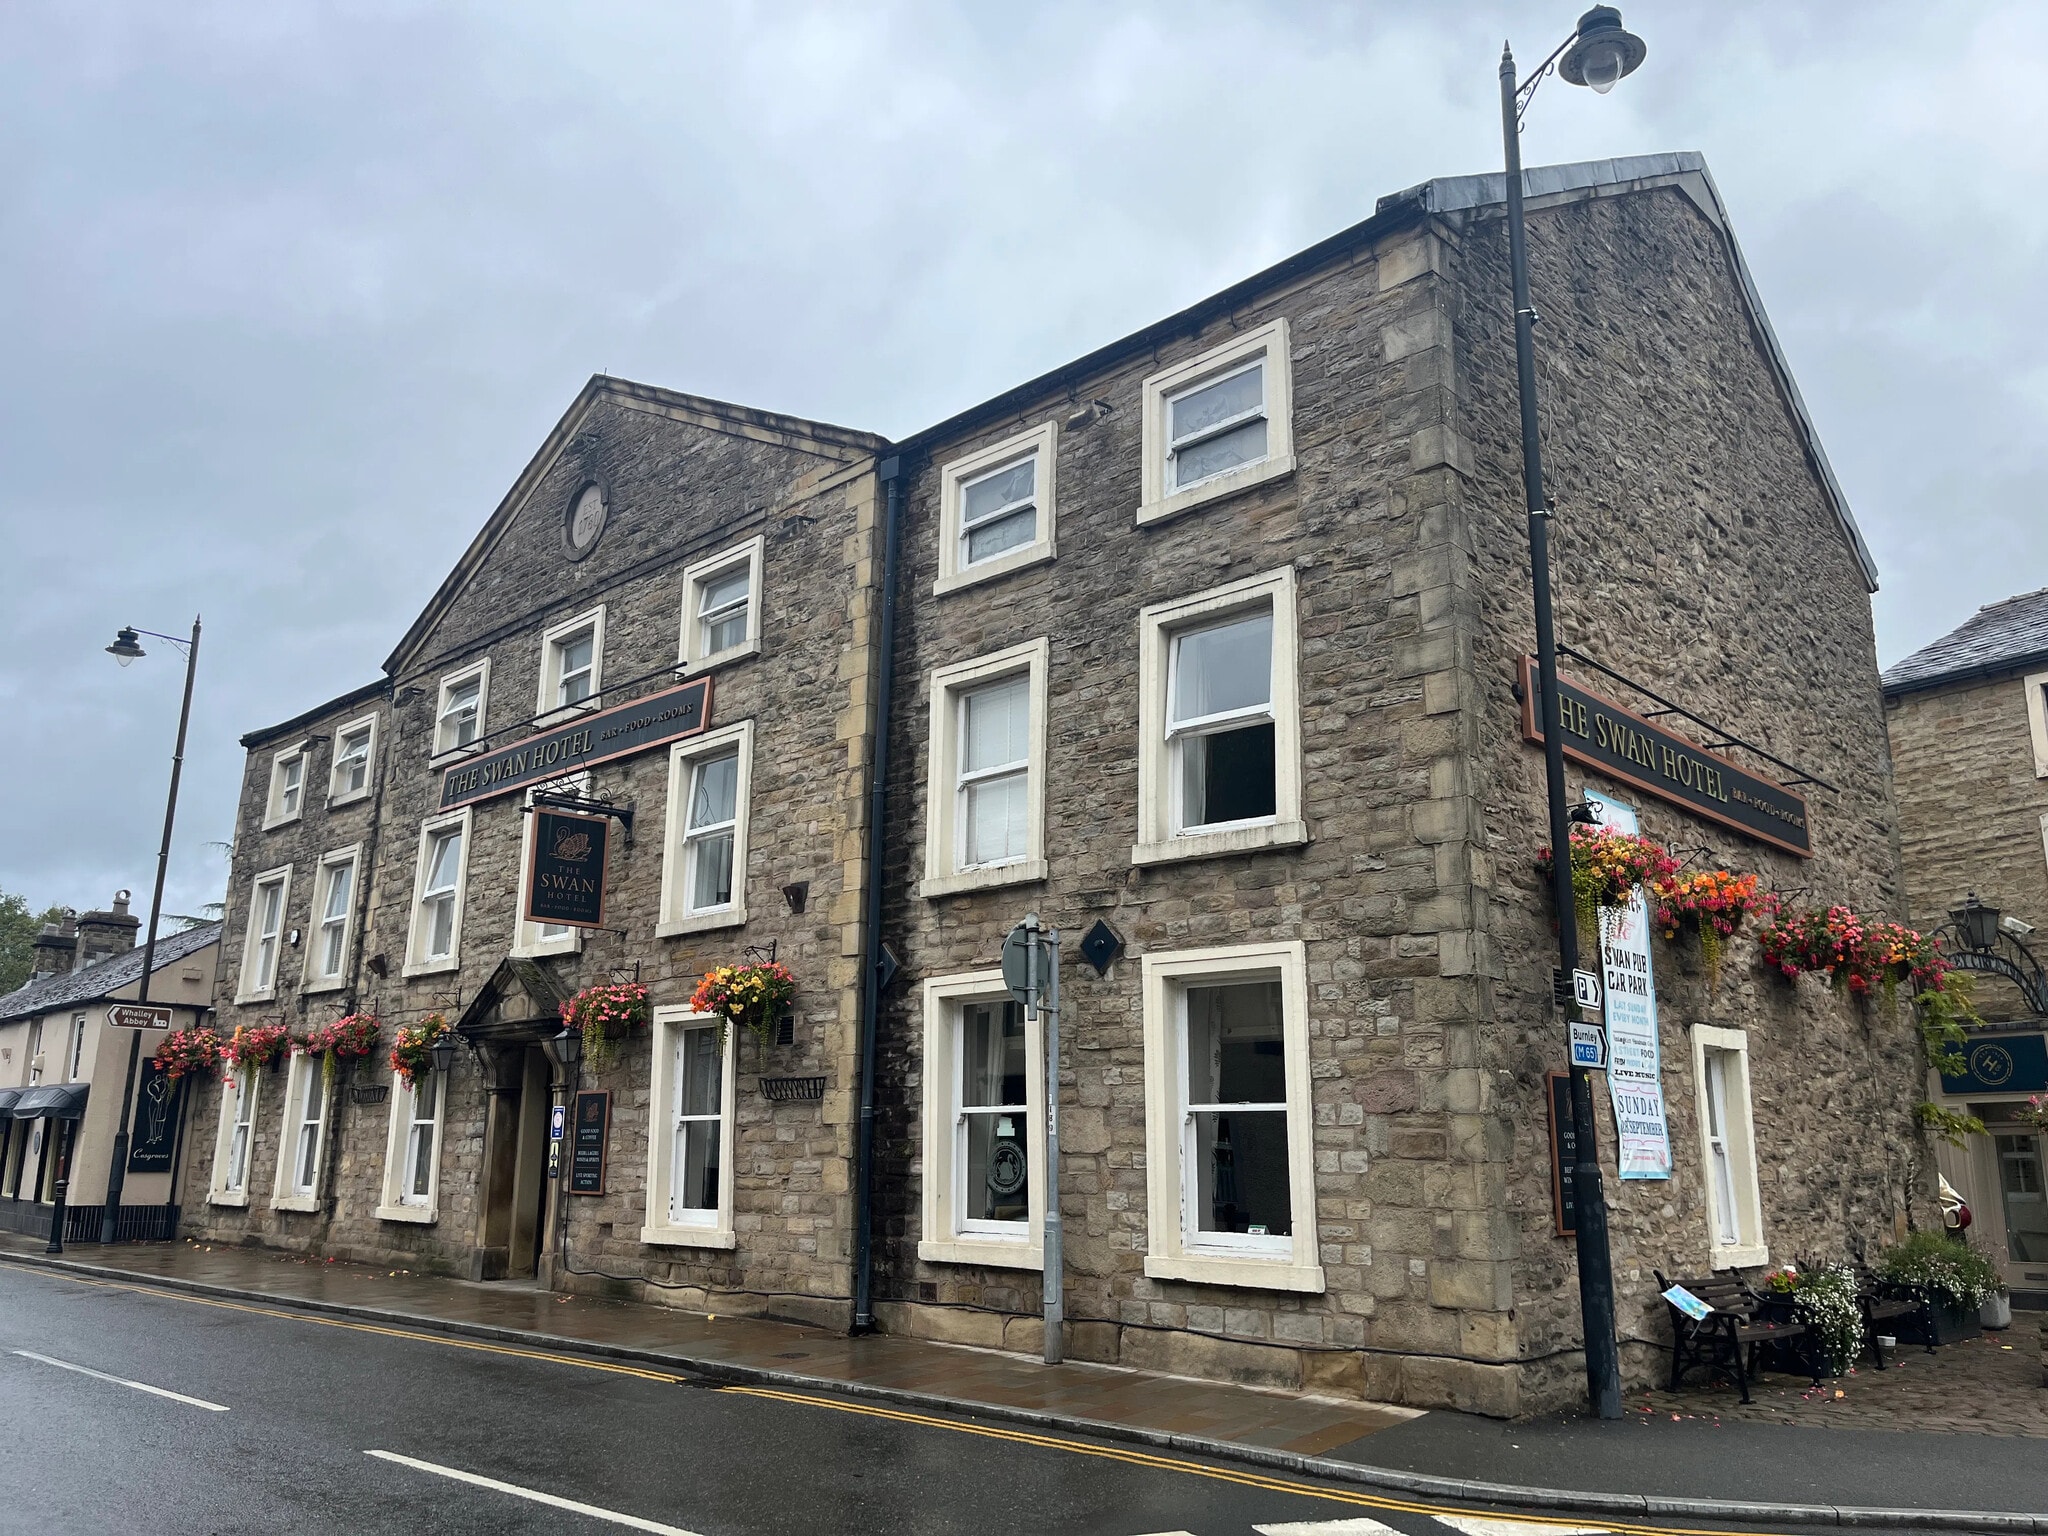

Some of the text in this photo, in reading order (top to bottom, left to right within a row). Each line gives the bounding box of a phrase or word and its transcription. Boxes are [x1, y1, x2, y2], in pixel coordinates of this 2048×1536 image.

[449, 703, 693, 797] THE SWAN HOTEL BAR FOOD ROOMS
[1595, 713, 1657, 771] SWAN
[1660, 745, 1728, 803] HOTEL
[1753, 797, 1775, 816] FOOD
[559, 865, 580, 875] THE
[540, 873, 595, 893] SWAN
[547, 891, 587, 903] HOTEL
[1605, 946, 1647, 973] SWAN PUB
[1608, 970, 1648, 997] CAR PARK
[122, 1008, 152, 1019] Whalley
[123, 1017, 148, 1027] Abbey
[1573, 1028, 1597, 1044] Burnley
[1614, 1069, 1656, 1079] LIVE MUSIC
[1618, 1095, 1659, 1117] SUNDAY
[1629, 1121, 1664, 1136] SEPTEMBER
